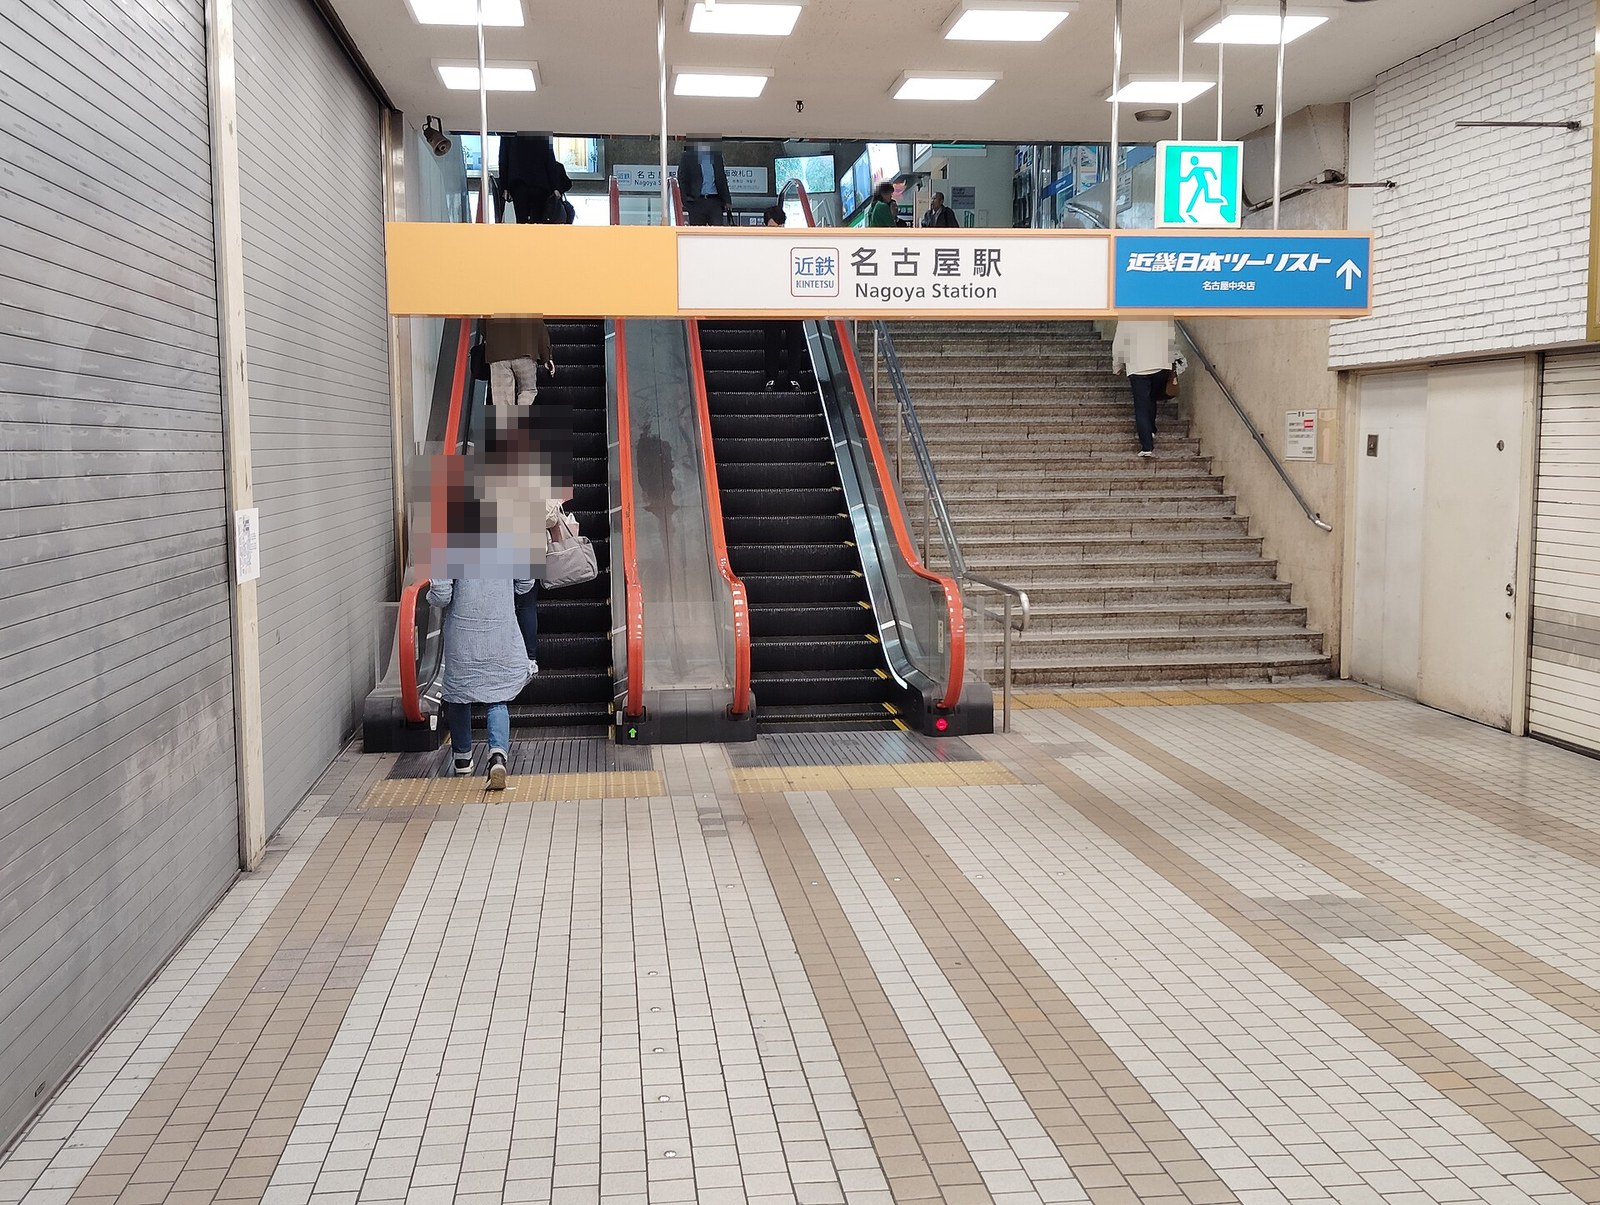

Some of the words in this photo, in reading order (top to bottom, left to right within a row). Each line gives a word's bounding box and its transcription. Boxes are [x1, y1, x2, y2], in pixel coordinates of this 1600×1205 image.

[634, 179, 657, 187] Nagoya
[795, 256, 835, 276] 近鉄
[851, 247, 1001, 277] 名古屋駅
[1126, 252, 1331, 272] 近畿日本ツーリスト
[796, 280, 834, 288] KINTETSU
[856, 283, 925, 302] Nagoya
[932, 283, 997, 298] Station
[1202, 281, 1255, 291] 名古屋中央店
